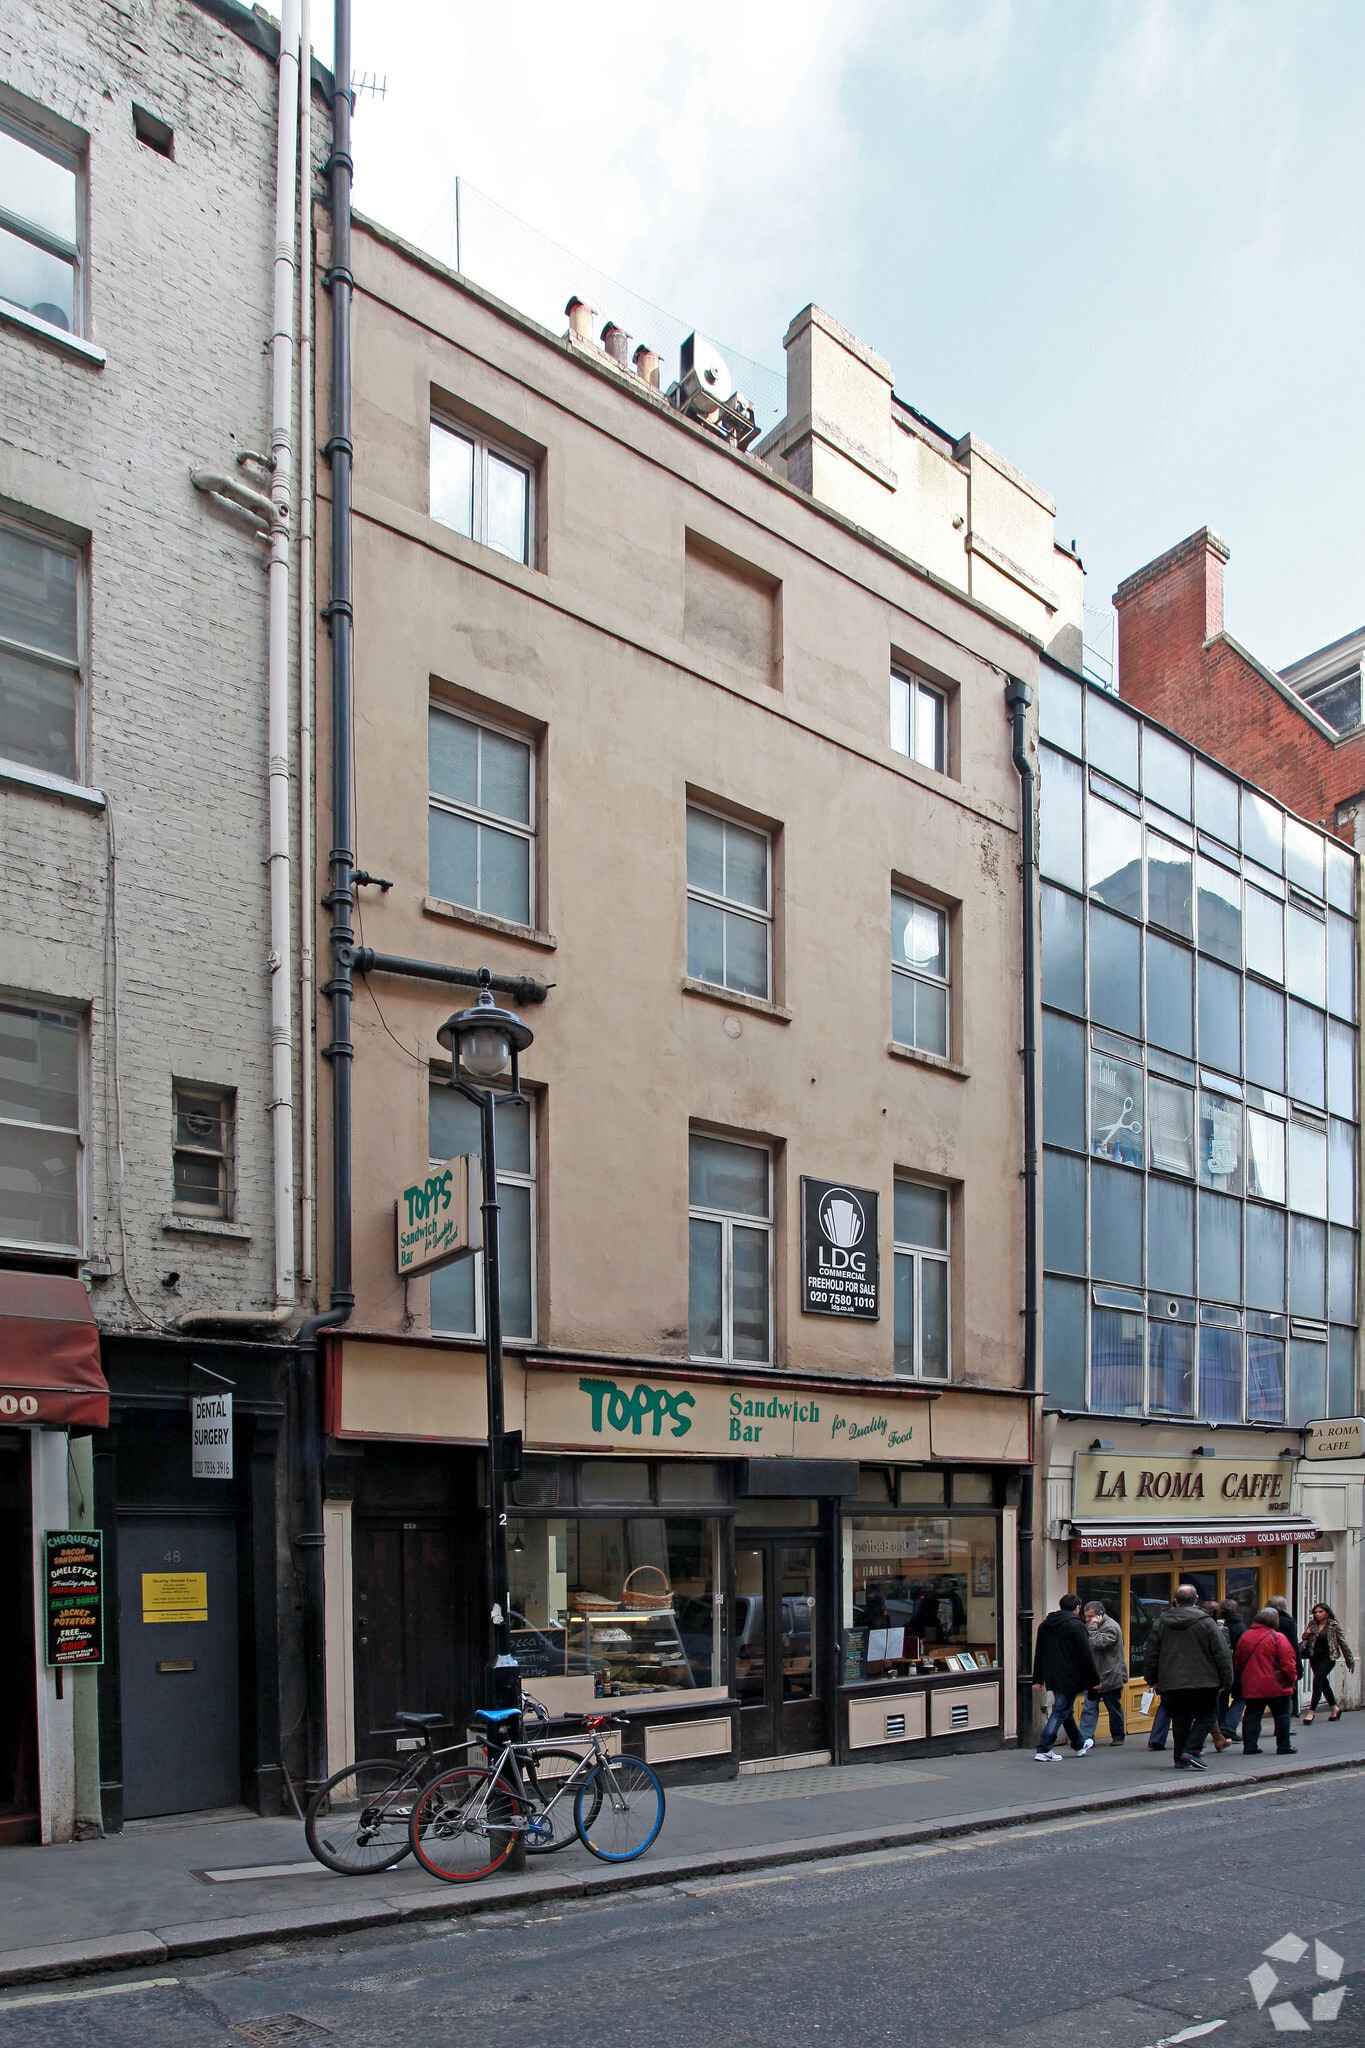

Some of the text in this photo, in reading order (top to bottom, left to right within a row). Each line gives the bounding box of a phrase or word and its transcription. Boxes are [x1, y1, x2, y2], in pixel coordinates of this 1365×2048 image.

[1098, 1060, 1117, 1087] Tailor
[403, 1170, 453, 1227] TOPPS
[401, 1218, 437, 1249] Sandwich
[424, 1219, 453, 1258] for Quality
[444, 1225, 458, 1250] Food
[401, 1251, 414, 1267] Bar
[819, 1246, 866, 1272] LDG
[819, 1267, 866, 1281] COMMERCIAL
[808, 1276, 876, 1296] FREEHOLD FOR SALE
[810, 1291, 875, 1309] 020 7580 1010
[831, 1304, 855, 1312] ldg.co.uk
[196, 1401, 227, 1419] DENTAL
[580, 1377, 695, 1438] TOPPS
[729, 1392, 820, 1423] Sandwich
[729, 1417, 763, 1443] Bar
[831, 1414, 888, 1441] for Quality
[1310, 1426, 1359, 1437] LA ROMA
[194, 1428, 229, 1446] SURGERY
[887, 1425, 913, 1448] Food
[1319, 1441, 1350, 1451] CAFFE
[194, 1461, 203, 1474] 020
[216, 1461, 230, 1475] 3916
[1095, 1470, 1283, 1498] LA ROMA CAFFE
[499, 1513, 508, 1526] 2
[47, 1534, 100, 1548] CHEQUERS
[1081, 1531, 1315, 1548] BREAKFAST LUNCH FRESH SANDWICHES COLD & HOT DRINKS
[54, 1554, 95, 1565] SANDWICH
[60, 1547, 86, 1556] BACON
[164, 1551, 181, 1563] 48
[51, 1566, 98, 1578] OMELETTES
[50, 1596, 99, 1608] SALAD BOXES
[53, 1616, 96, 1627] POTATOES
[59, 1608, 91, 1618] JACKET
[61, 1640, 88, 1651] SOUP
